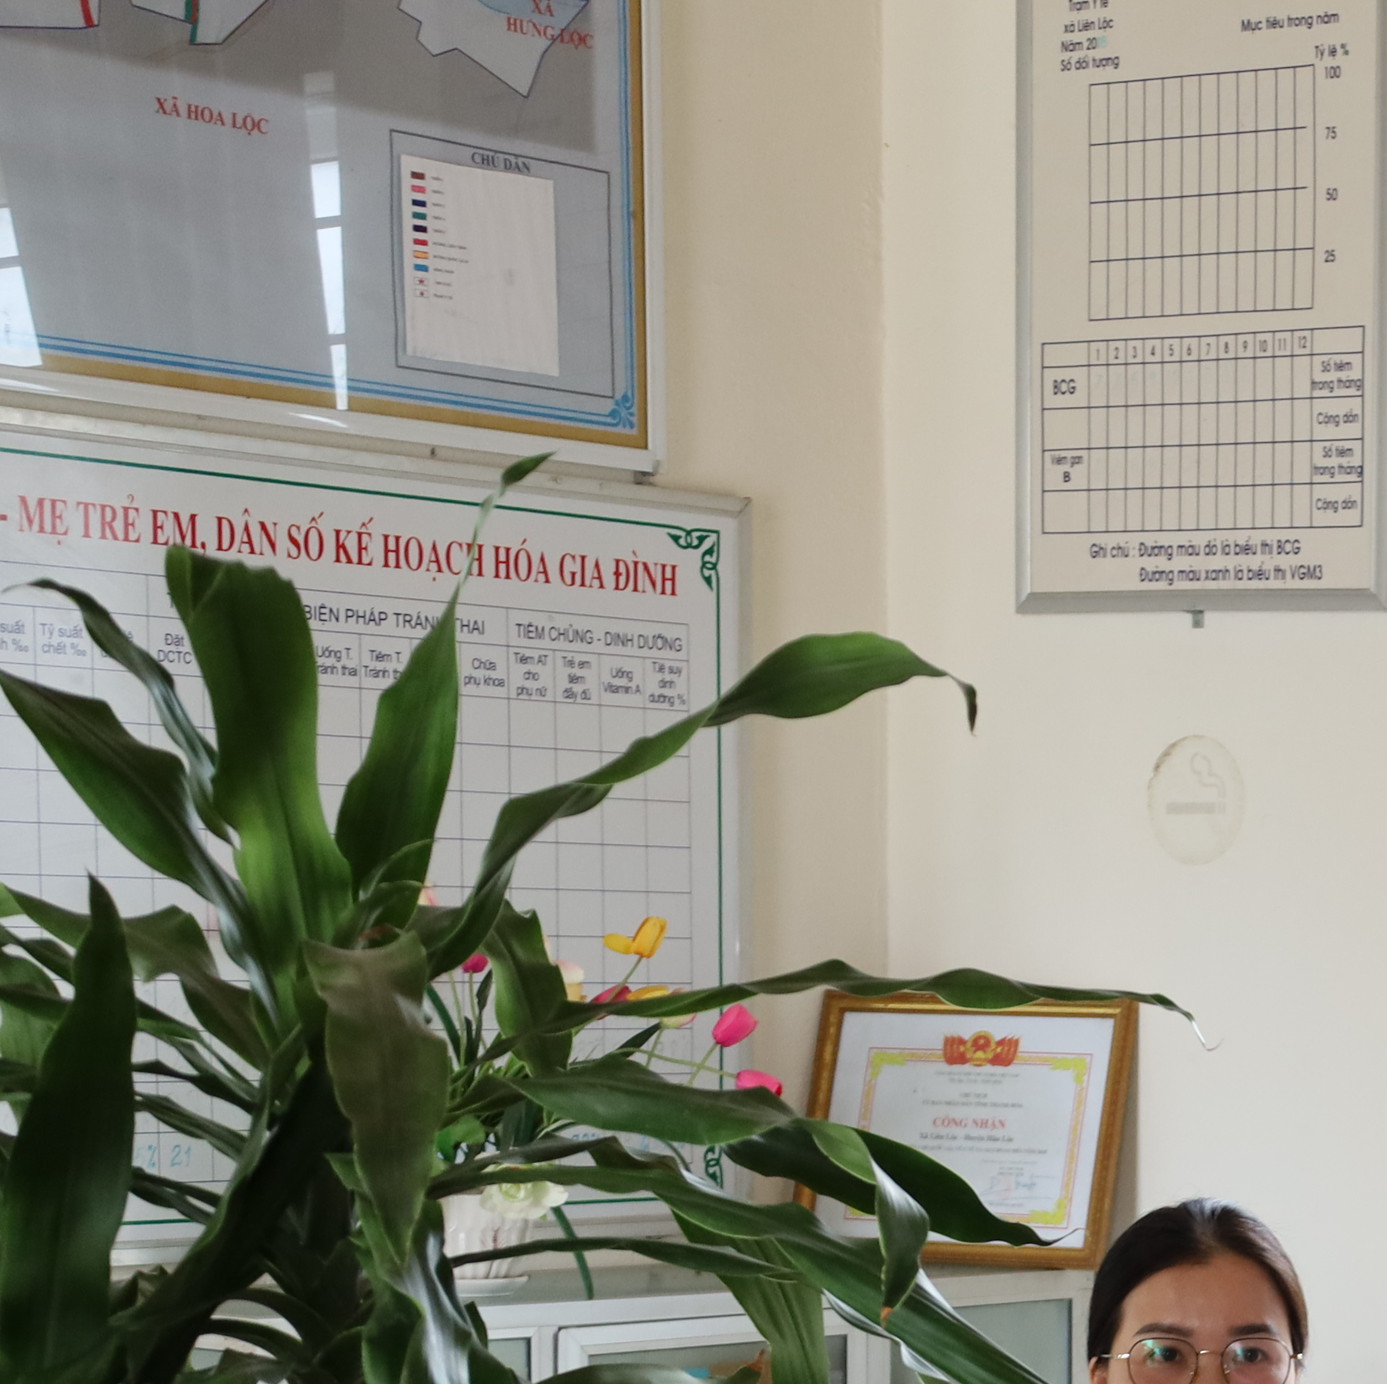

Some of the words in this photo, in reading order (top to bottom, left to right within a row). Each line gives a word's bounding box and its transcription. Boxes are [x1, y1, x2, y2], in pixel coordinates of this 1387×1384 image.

[1287, 14, 1314, 30] trong
[1324, 65, 1341, 79] 100
[155, 96, 181, 118] XÃ
[187, 102, 225, 127] HOA
[231, 108, 270, 136] LỘC
[1325, 127, 1337, 140] 75
[1325, 188, 1338, 202] 50
[1324, 250, 1336, 263] 25
[1113, 347, 1120, 360] 2
[1132, 345, 1138, 359] 3
[1150, 344, 1156, 357] 4
[1168, 344, 1175, 357] 5
[1186, 344, 1193, 356] 6
[1205, 343, 1212, 356] 7
[1223, 341, 1230, 354] 8
[1242, 340, 1249, 353] 9
[1259, 339, 1268, 353] 10
[1298, 335, 1307, 349] 12
[1053, 379, 1076, 395] BCG
[1063, 471, 1071, 483] B
[17, 493, 69, 545] MẸ
[76, 494, 142, 544] TRẺ
[215, 508, 278, 557] DÂN
[286, 511, 326, 562] SỐ
[333, 516, 374, 567] KẾ
[382, 534, 485, 581] HOẠCH
[493, 538, 552, 585] HÓA
[558, 551, 607, 590] GIA
[612, 549, 679, 598] ĐÌNH
[1090, 543, 1107, 558] Ghi
[1276, 538, 1301, 556] BCG
[1203, 566, 1231, 581] xanh
[345, 608, 388, 627] PHÁP
[393, 612, 441, 632] TRÁN
[604, 631, 634, 648] DINH
